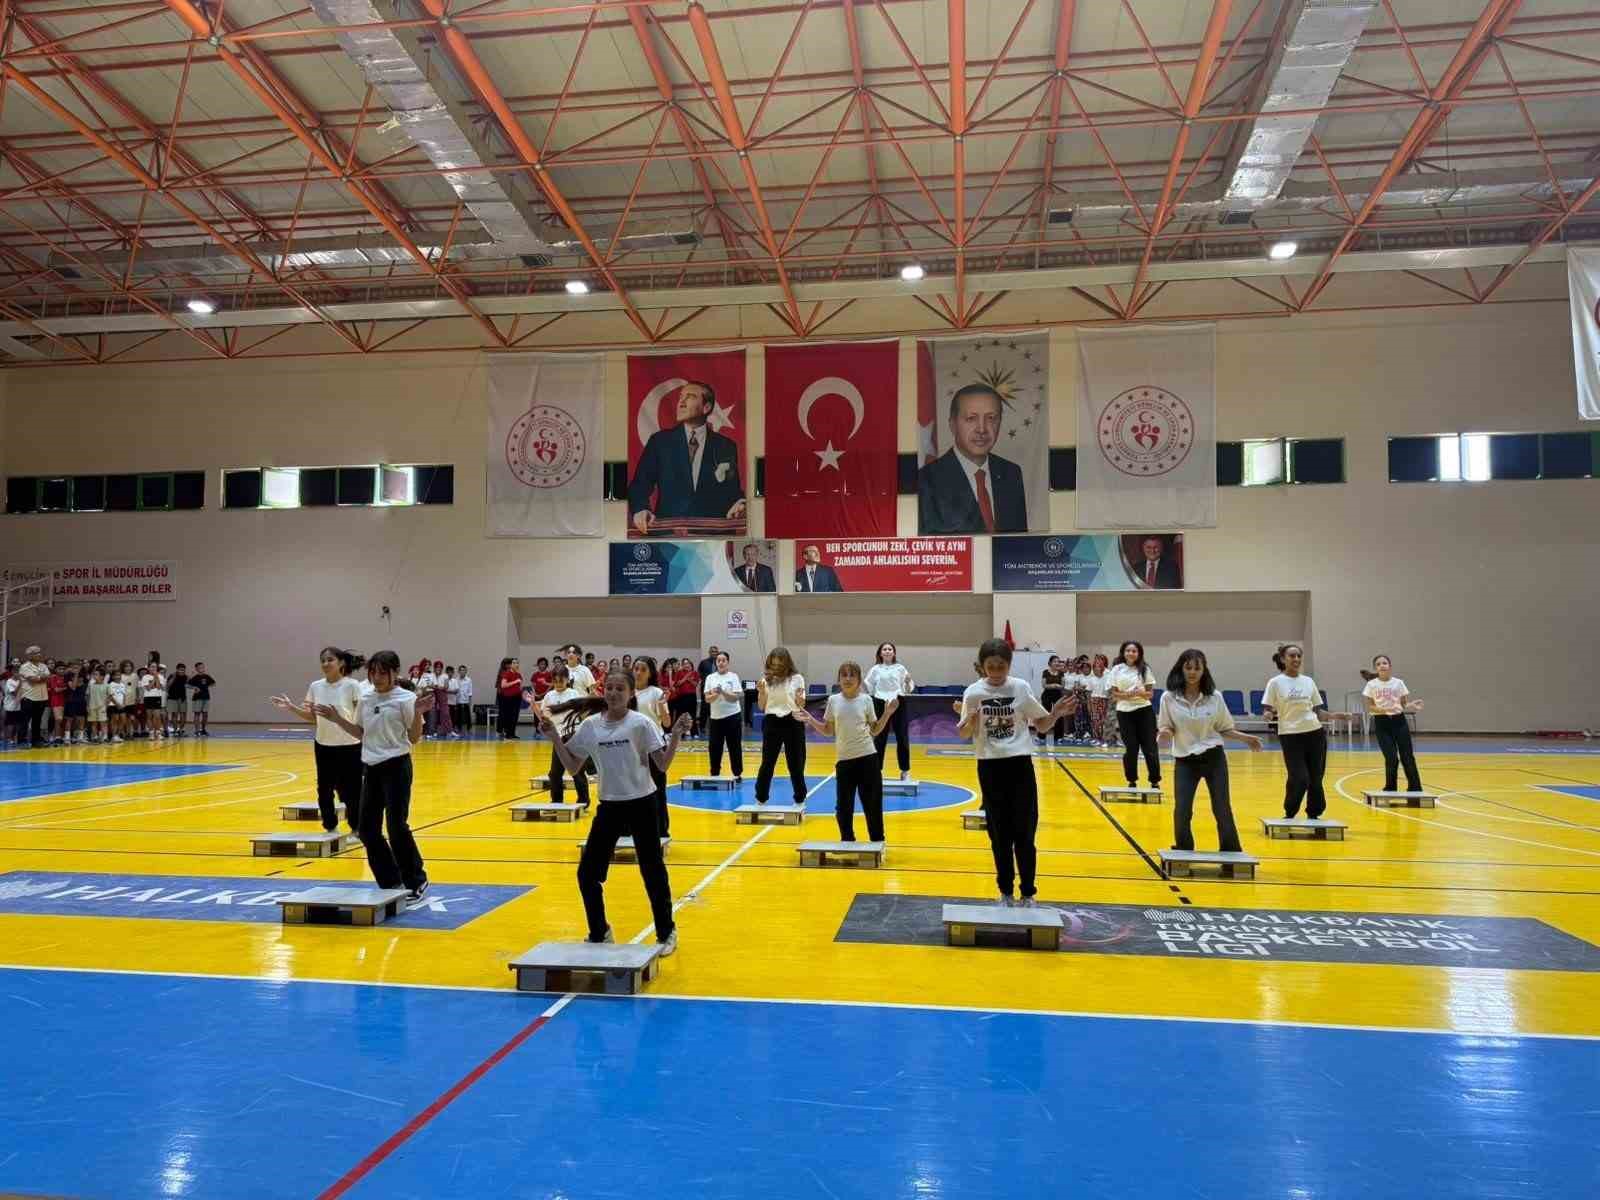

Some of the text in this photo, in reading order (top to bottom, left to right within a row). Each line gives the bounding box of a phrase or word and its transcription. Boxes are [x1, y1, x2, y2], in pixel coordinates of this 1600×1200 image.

[842, 541, 888, 552] SPORCUNUN
[911, 539, 934, 553] ÇEVİK
[935, 541, 946, 551] VE
[947, 540, 967, 551] AYNI
[834, 556, 872, 567] ZAMANDA
[63, 567, 90, 579] SPOR
[92, 565, 101, 578] İL
[104, 564, 169, 578] MÜDÜRLÜĞÜ
[82, 584, 138, 596] BAŞARILAR
[142, 583, 172, 594] DİLER
[42, 885, 476, 912] HALKBK
[1200, 912, 1461, 929] HALKBANK
[1156, 930, 1501, 952] BASKETBOL
